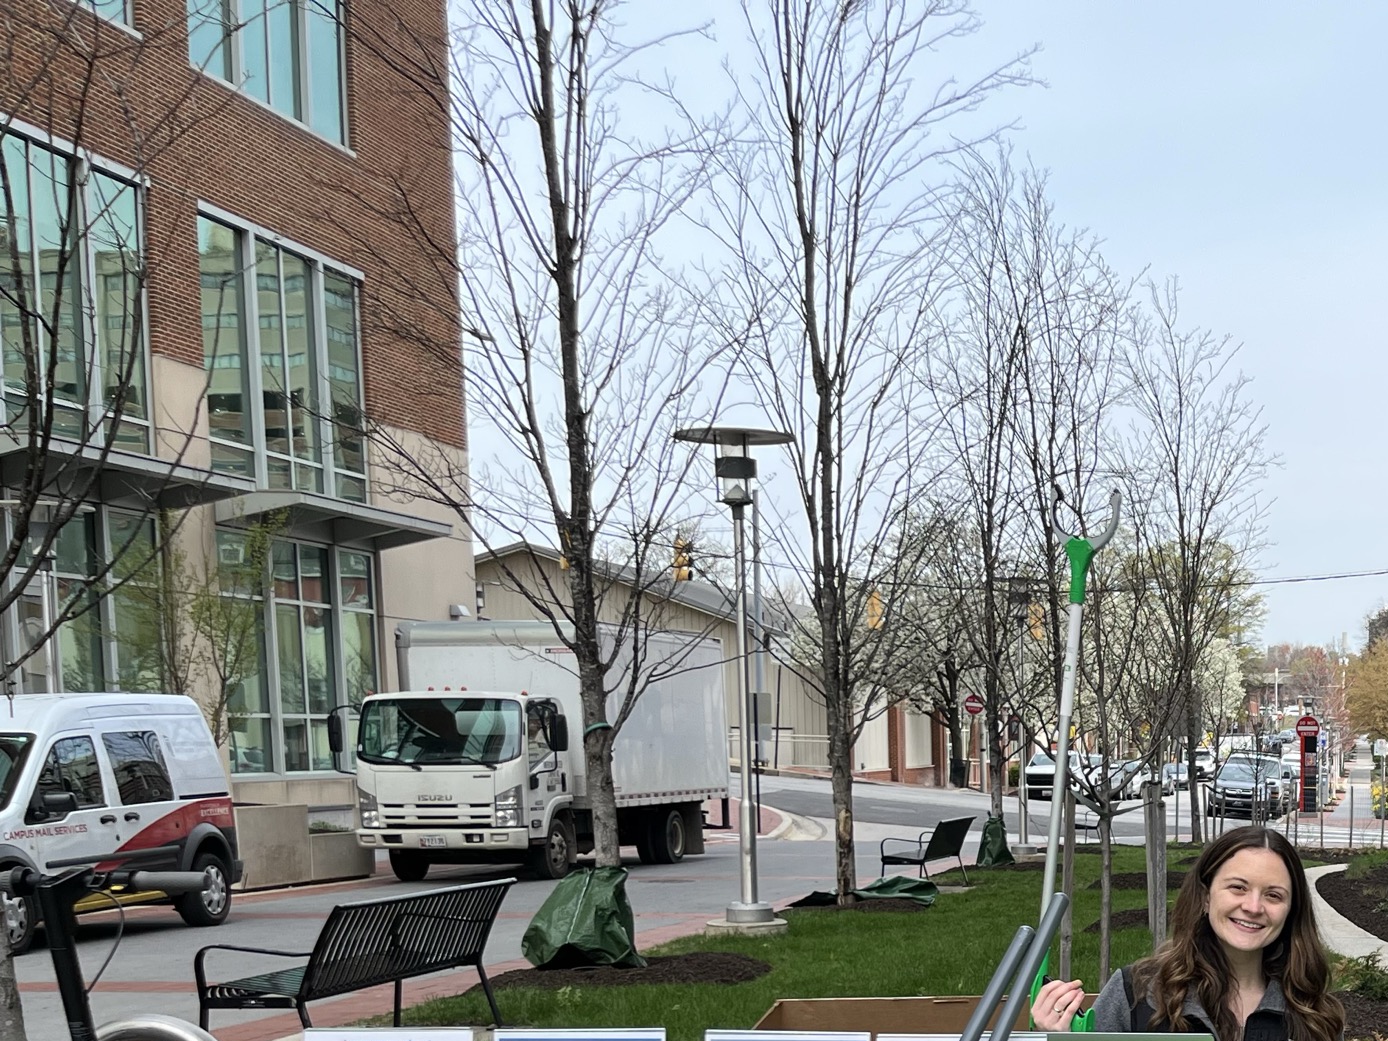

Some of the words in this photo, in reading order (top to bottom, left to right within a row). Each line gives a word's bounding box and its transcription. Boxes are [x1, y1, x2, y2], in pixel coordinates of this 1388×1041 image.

[418, 794, 453, 802] ISUZU
[4, 827, 34, 841] CAMPUS
[35, 826, 53, 837] MAIL
[55, 824, 88, 835] SERVICES
